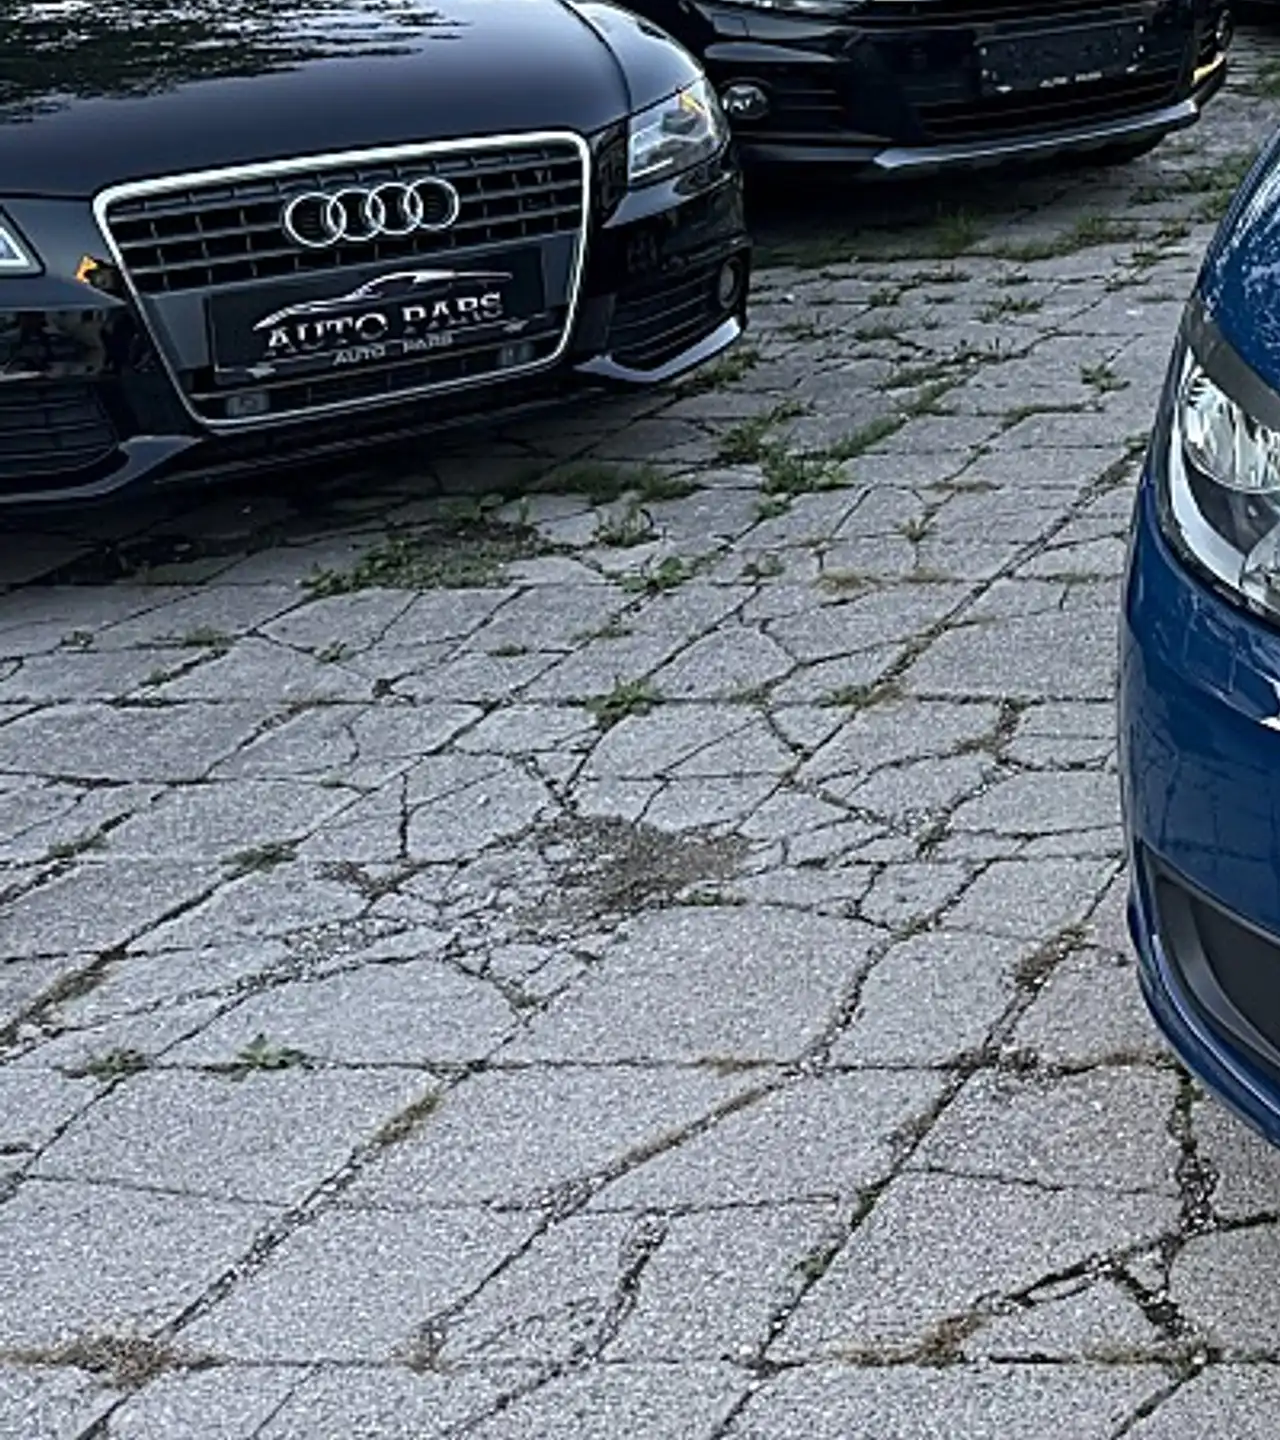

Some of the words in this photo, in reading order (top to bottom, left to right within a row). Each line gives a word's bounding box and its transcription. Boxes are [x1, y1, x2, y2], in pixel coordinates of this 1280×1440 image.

[265, 313, 389, 357] AUTO
[332, 345, 387, 366] AUTO
[402, 332, 454, 354] PARS
